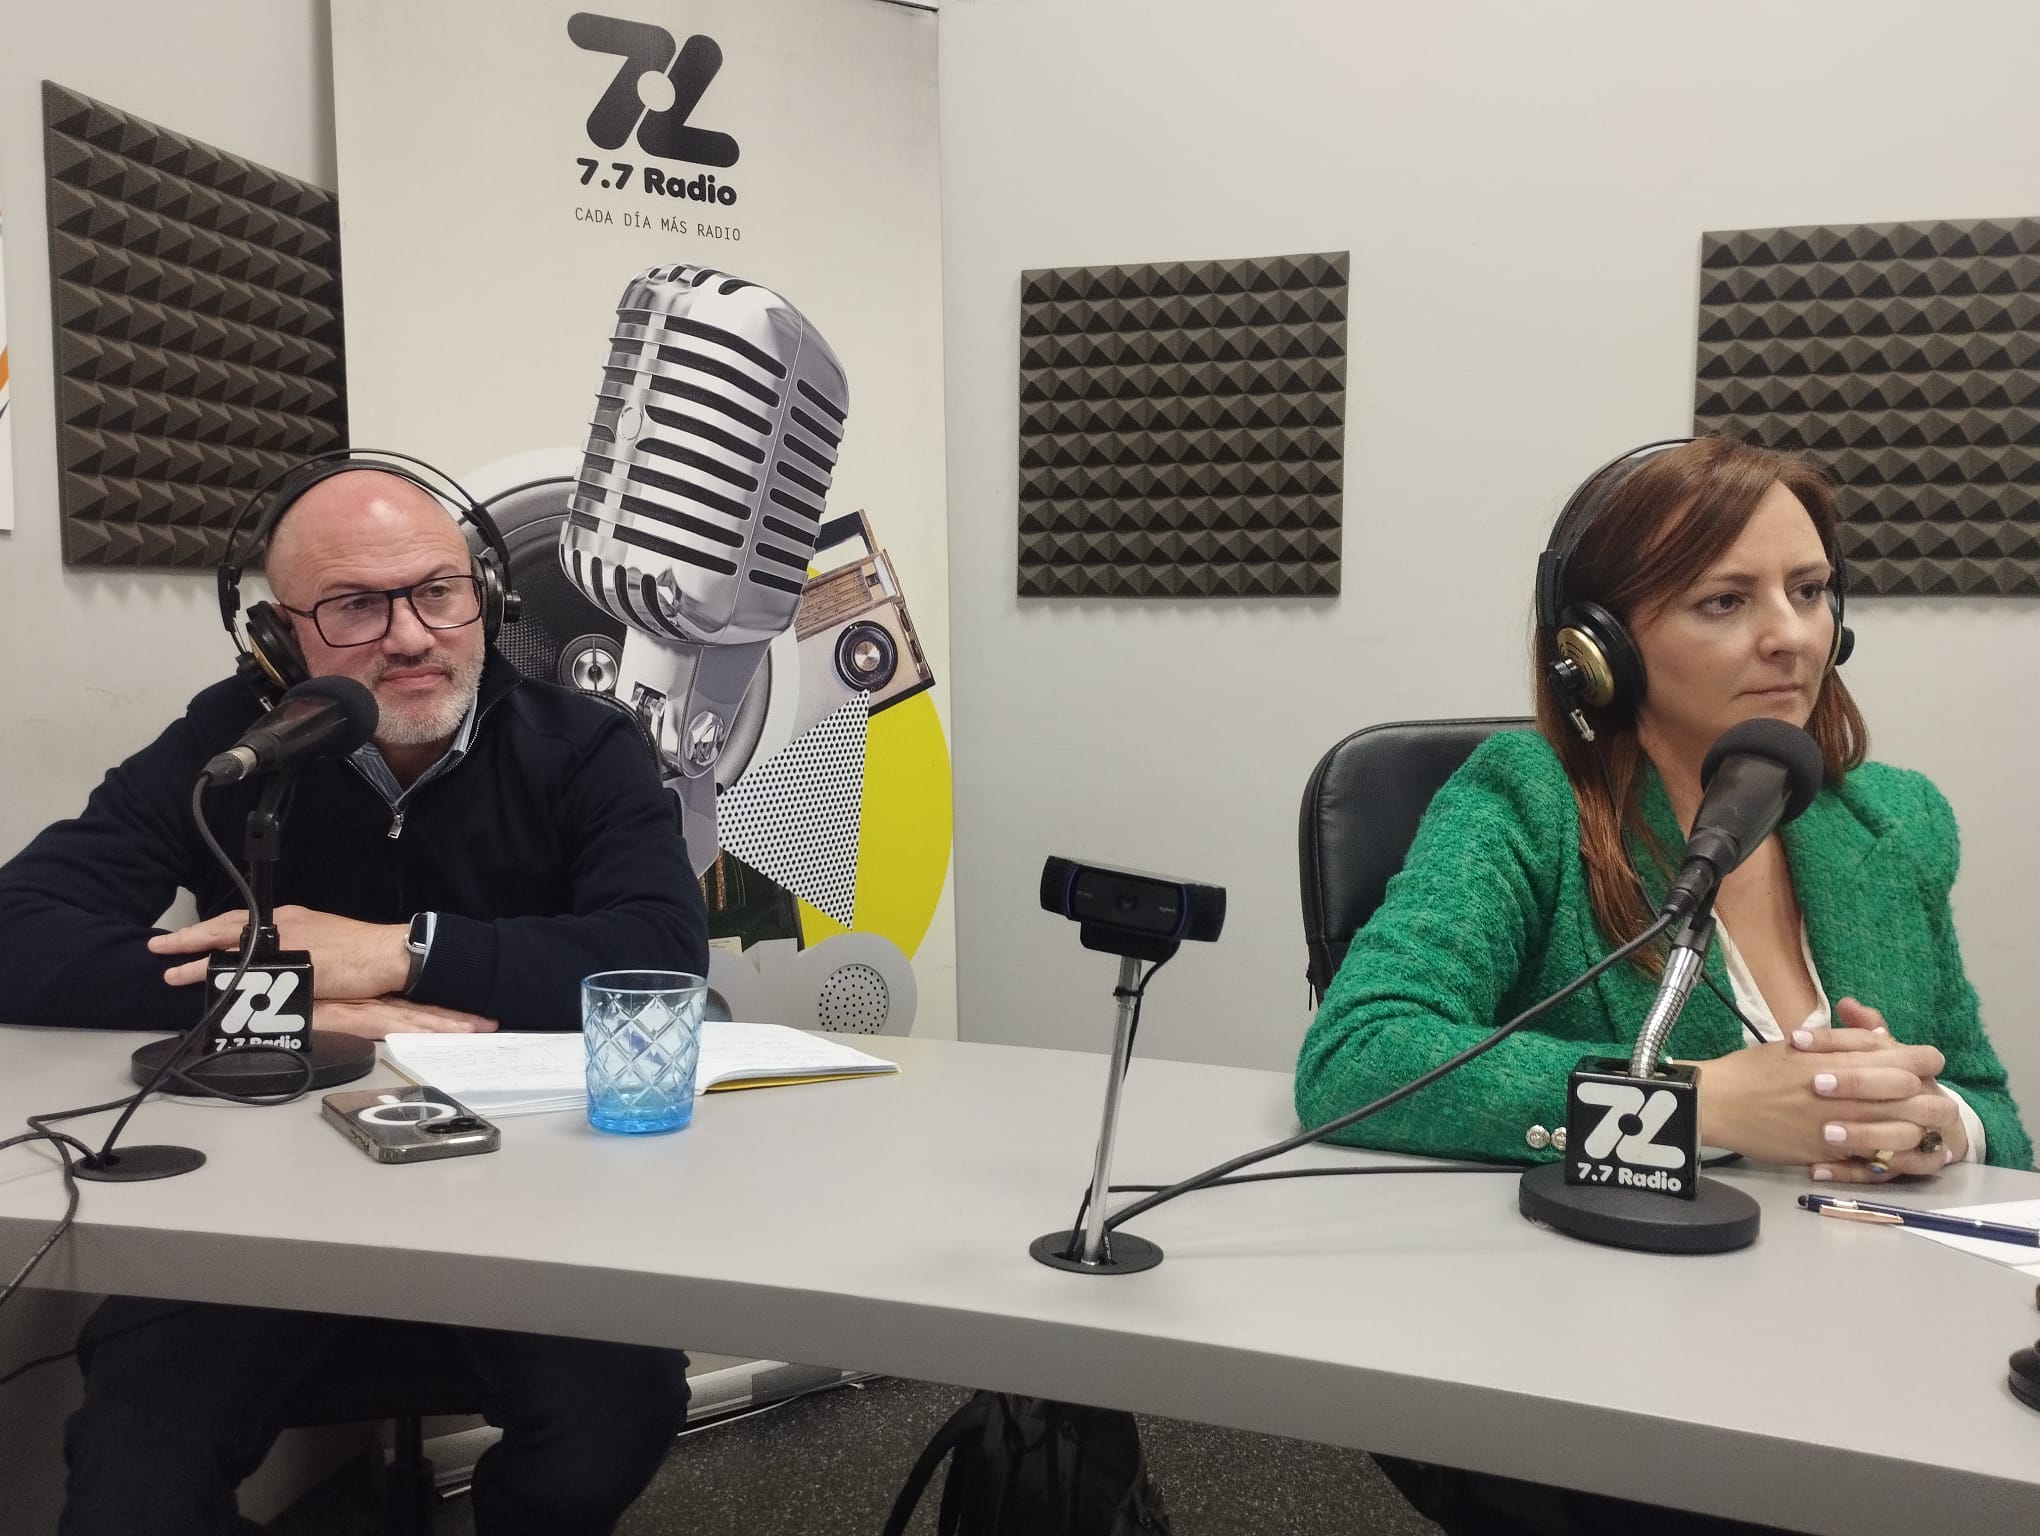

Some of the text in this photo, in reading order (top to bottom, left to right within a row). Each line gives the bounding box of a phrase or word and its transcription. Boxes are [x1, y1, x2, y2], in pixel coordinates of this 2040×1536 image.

[576, 157, 737, 206] 7.7 Radio
[575, 207, 741, 241] CADA DÍA MÁS RADIO
[1577, 1162, 1682, 1192] 7.7 Radio
